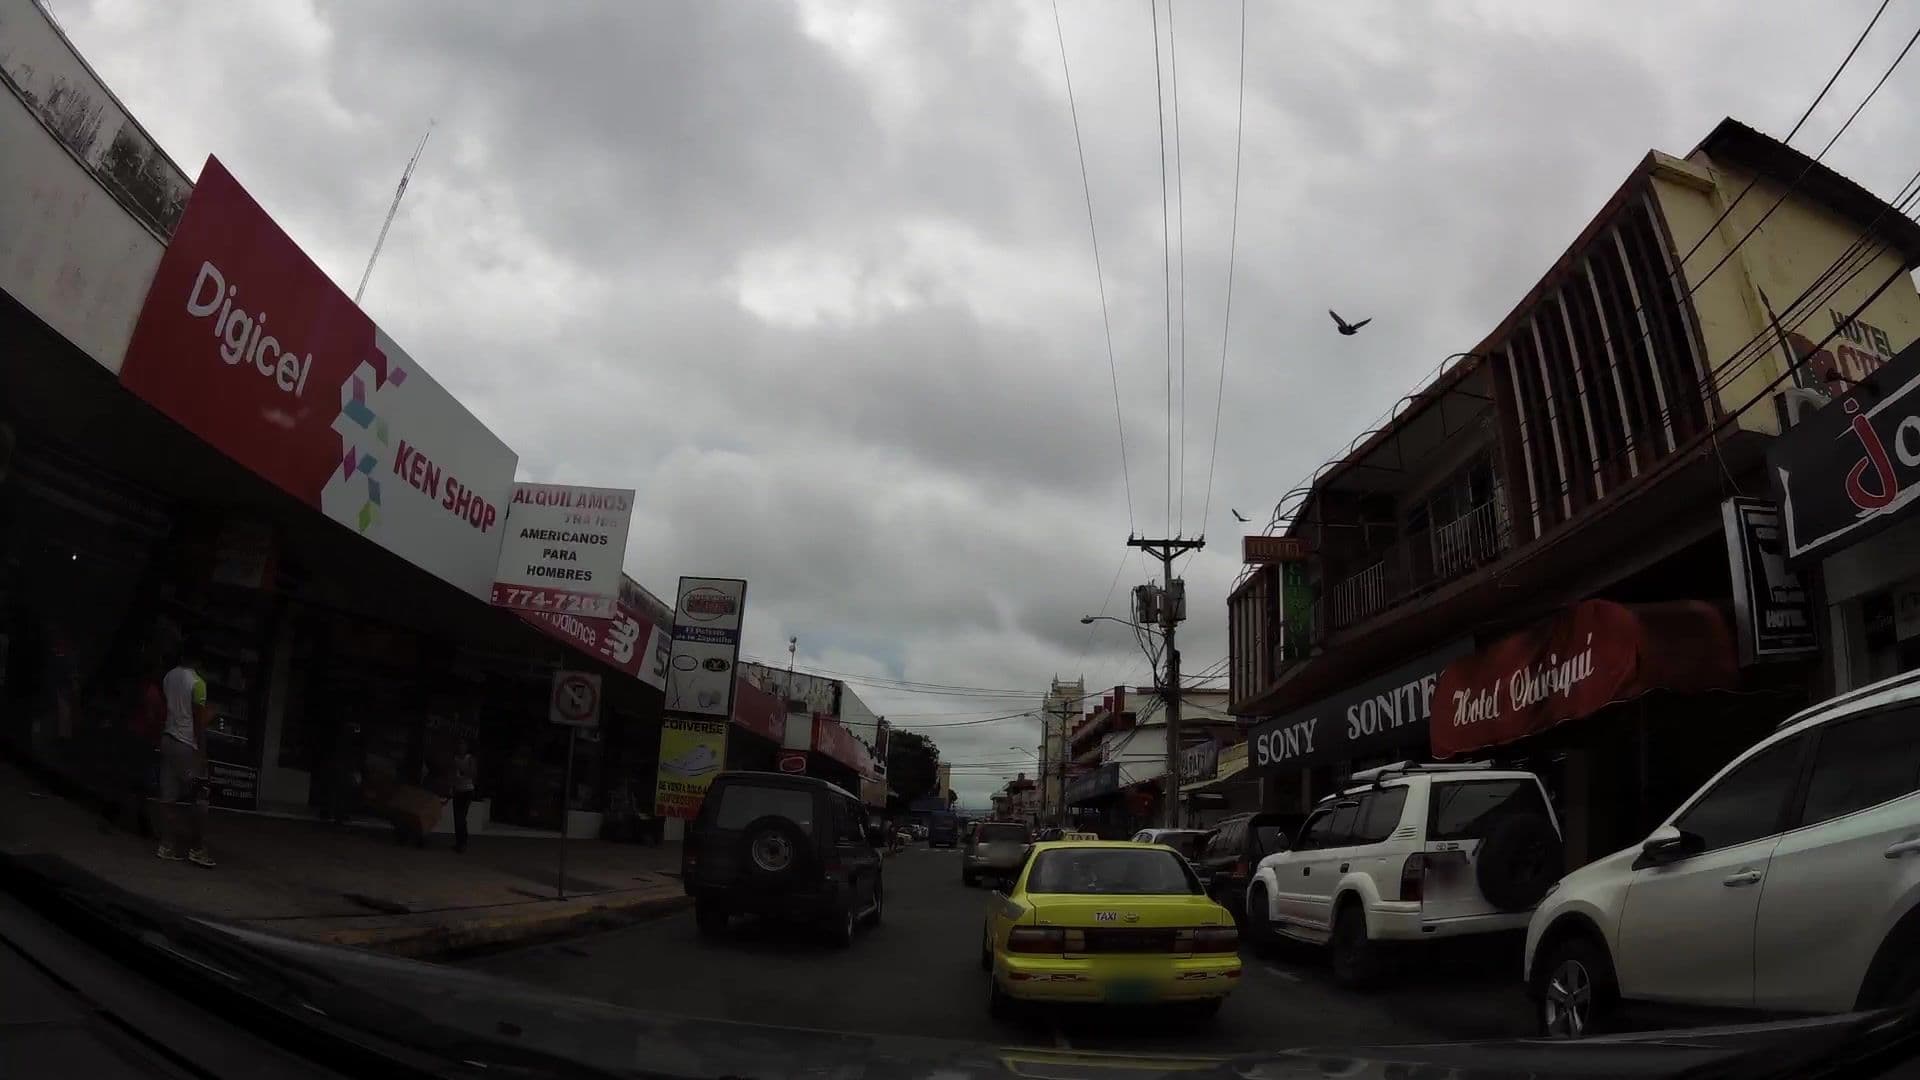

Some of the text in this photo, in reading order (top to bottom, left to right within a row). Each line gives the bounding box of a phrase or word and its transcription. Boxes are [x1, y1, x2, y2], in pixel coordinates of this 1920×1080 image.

[186, 261, 313, 398] Digicel
[1829, 308, 1895, 357] HOTEL
[393, 440, 496, 533] KEN SHOP
[512, 488, 628, 511] ALQUILAMOS
[520, 528, 608, 545] AMERICANOS
[543, 549, 578, 561] PARA
[526, 564, 593, 581] HOMBRES
[1452, 678, 1501, 727] Hotel
[663, 719, 723, 734] CONVERSE
[1257, 670, 1446, 767] SONY SONITE
[1095, 912, 1117, 921] TAXI
